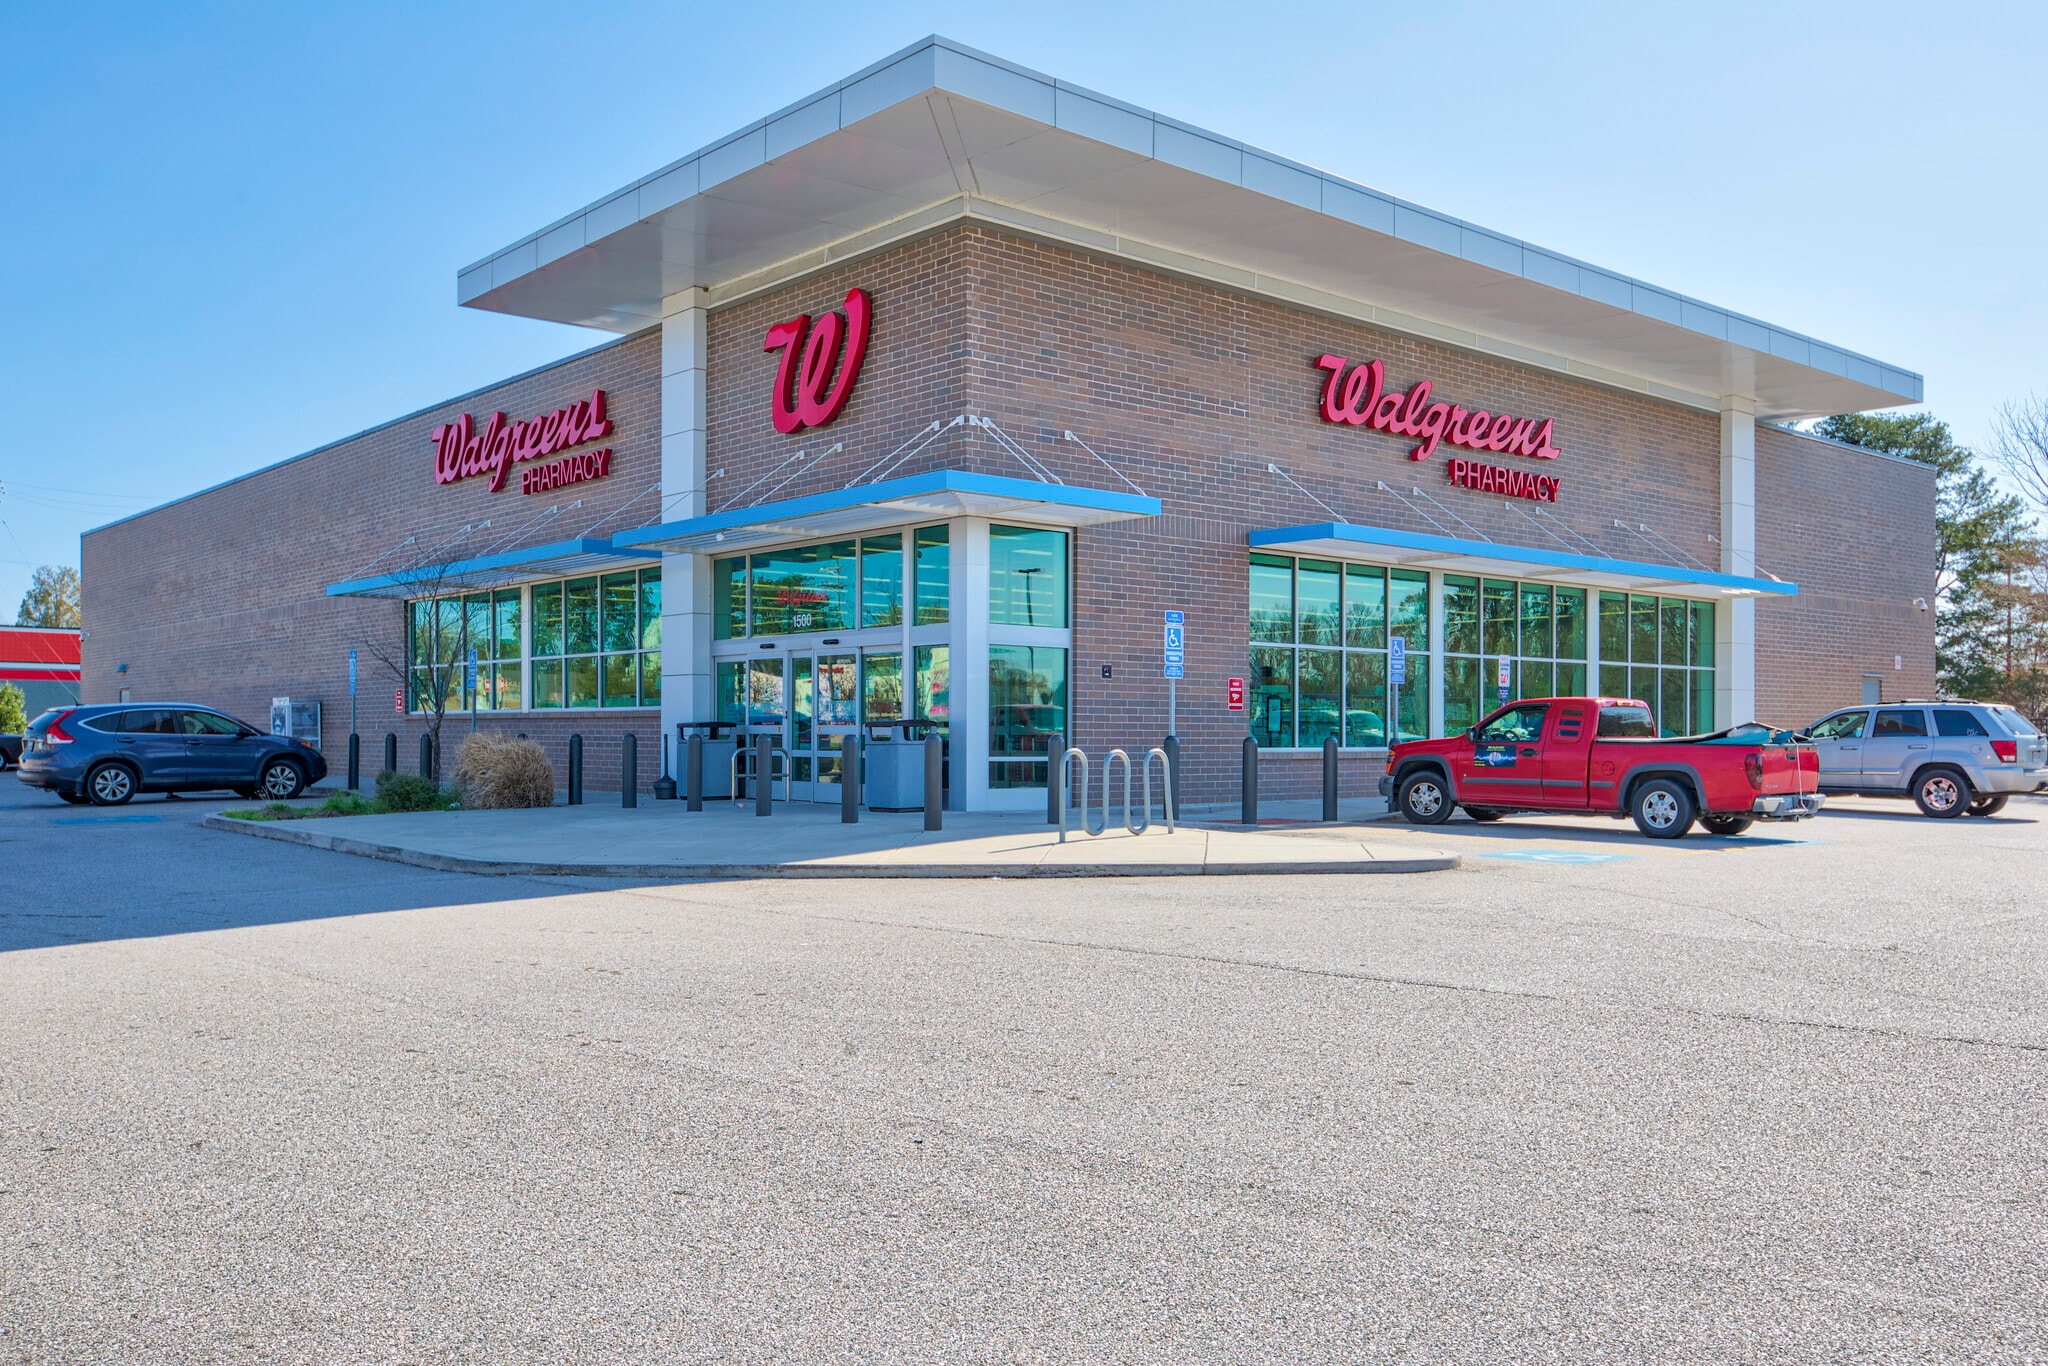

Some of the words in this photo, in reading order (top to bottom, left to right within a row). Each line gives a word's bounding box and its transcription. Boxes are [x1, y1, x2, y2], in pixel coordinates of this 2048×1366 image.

[763, 287, 871, 434] W
[431, 389, 613, 493] Walgreens
[1313, 353, 1561, 461] Walgreens
[521, 448, 612, 495] PHARMACY
[1448, 458, 1561, 502] PHARMACY
[792, 613, 812, 627] 1500
